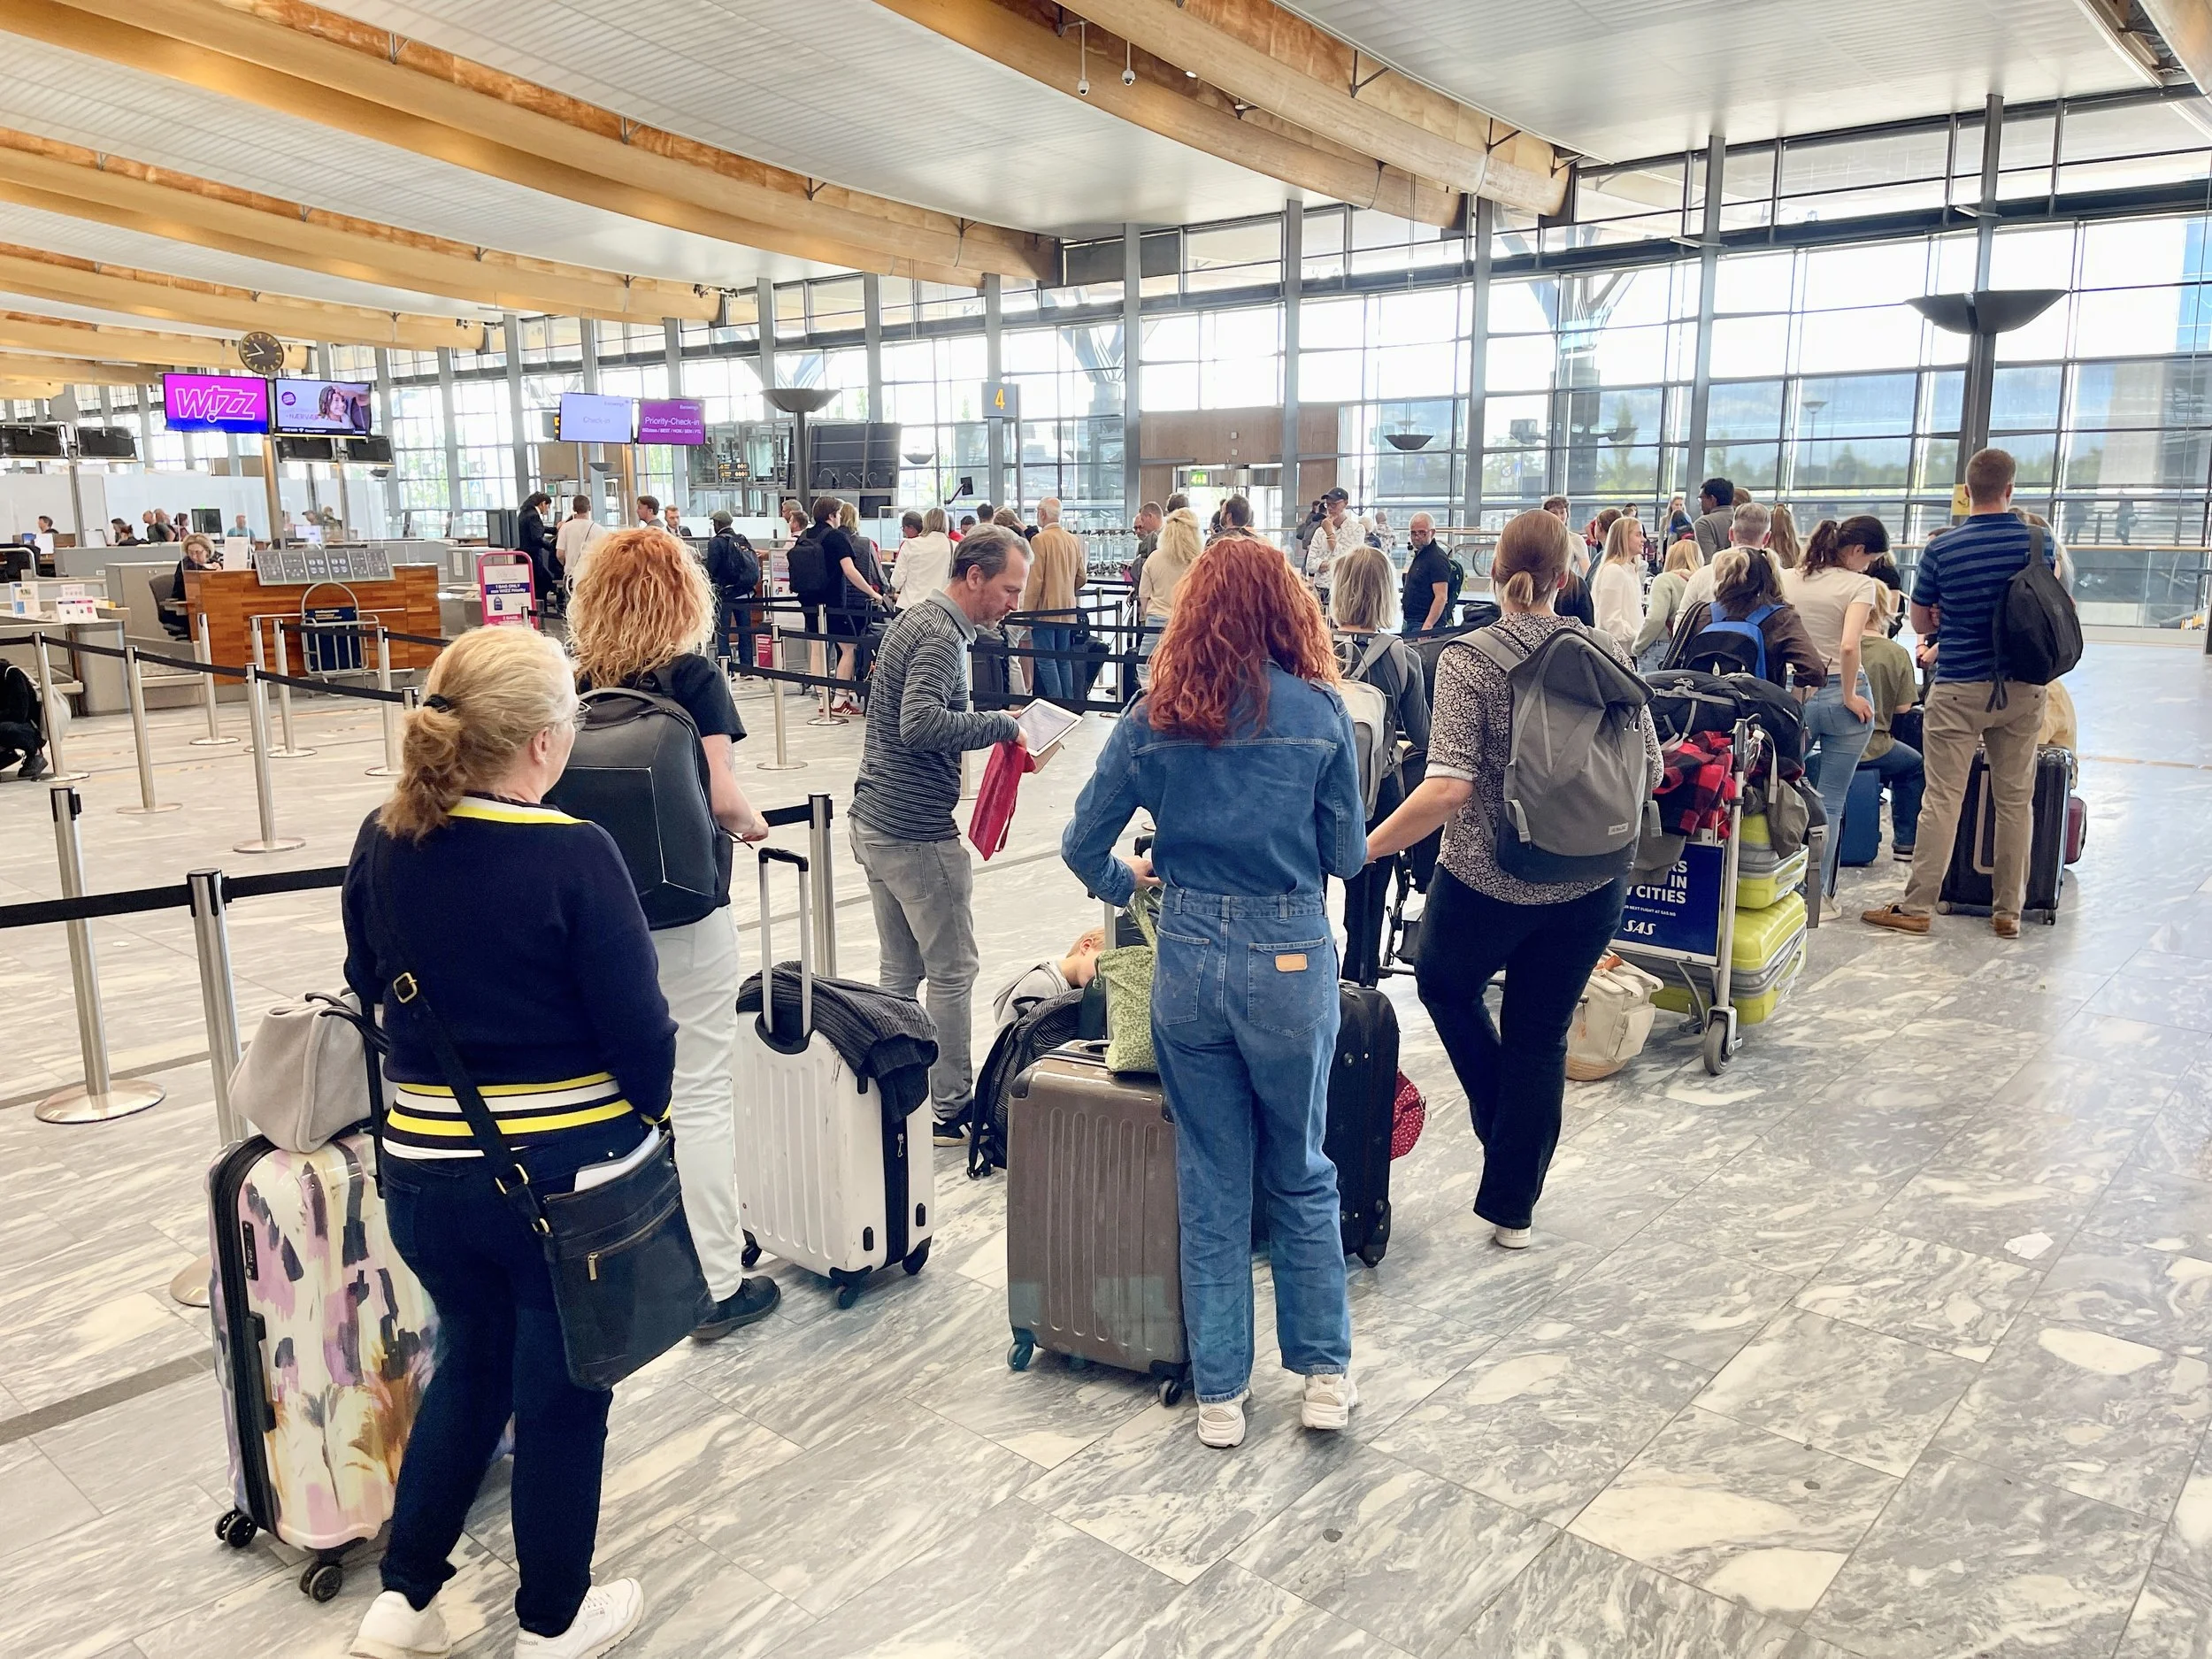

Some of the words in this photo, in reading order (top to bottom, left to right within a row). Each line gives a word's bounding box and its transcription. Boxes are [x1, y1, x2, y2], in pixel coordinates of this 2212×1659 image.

[995, 388, 1005, 410] 4
[644, 416, 700, 426] Priority-Check-in
[1671, 874, 1687, 889] IN
[1636, 885, 1686, 904] CITIES
[1623, 919, 1656, 935] SAS
